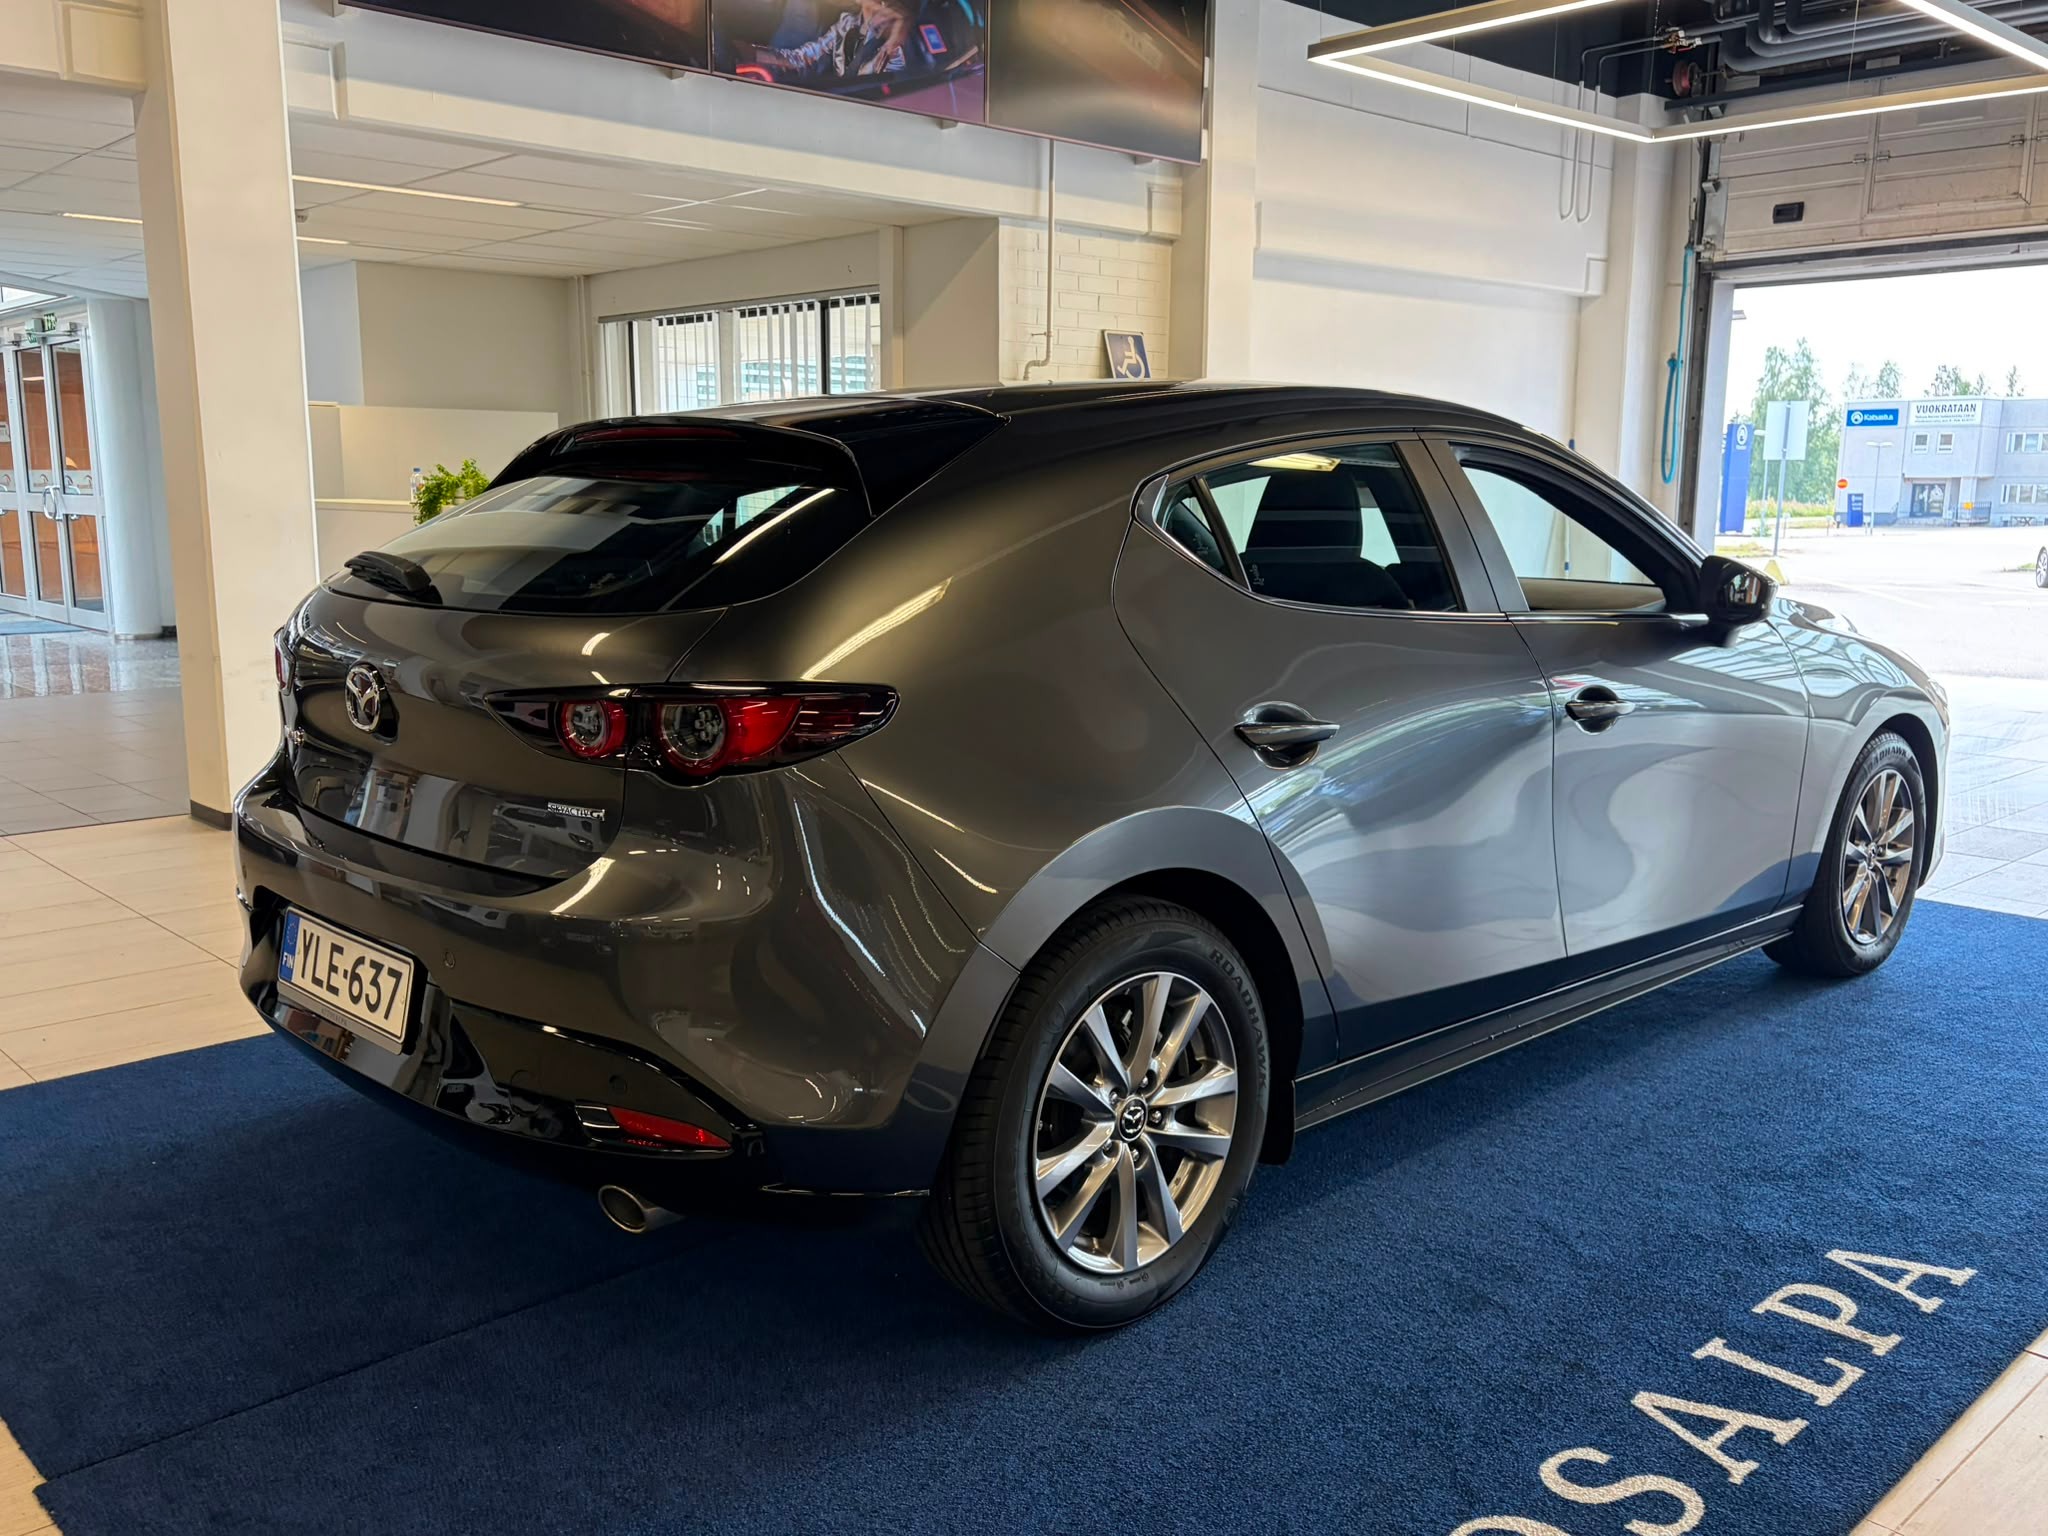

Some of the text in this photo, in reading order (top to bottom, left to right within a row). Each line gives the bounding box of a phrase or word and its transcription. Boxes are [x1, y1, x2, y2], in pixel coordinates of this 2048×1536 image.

[1916, 403, 1977, 414] VUOKRATAAN
[282, 951, 294, 969] FIN
[301, 928, 403, 1020] YLE-637
[1209, 948, 1268, 1089] ROADHAWK
[1450, 1248, 1978, 1536] SALPA
